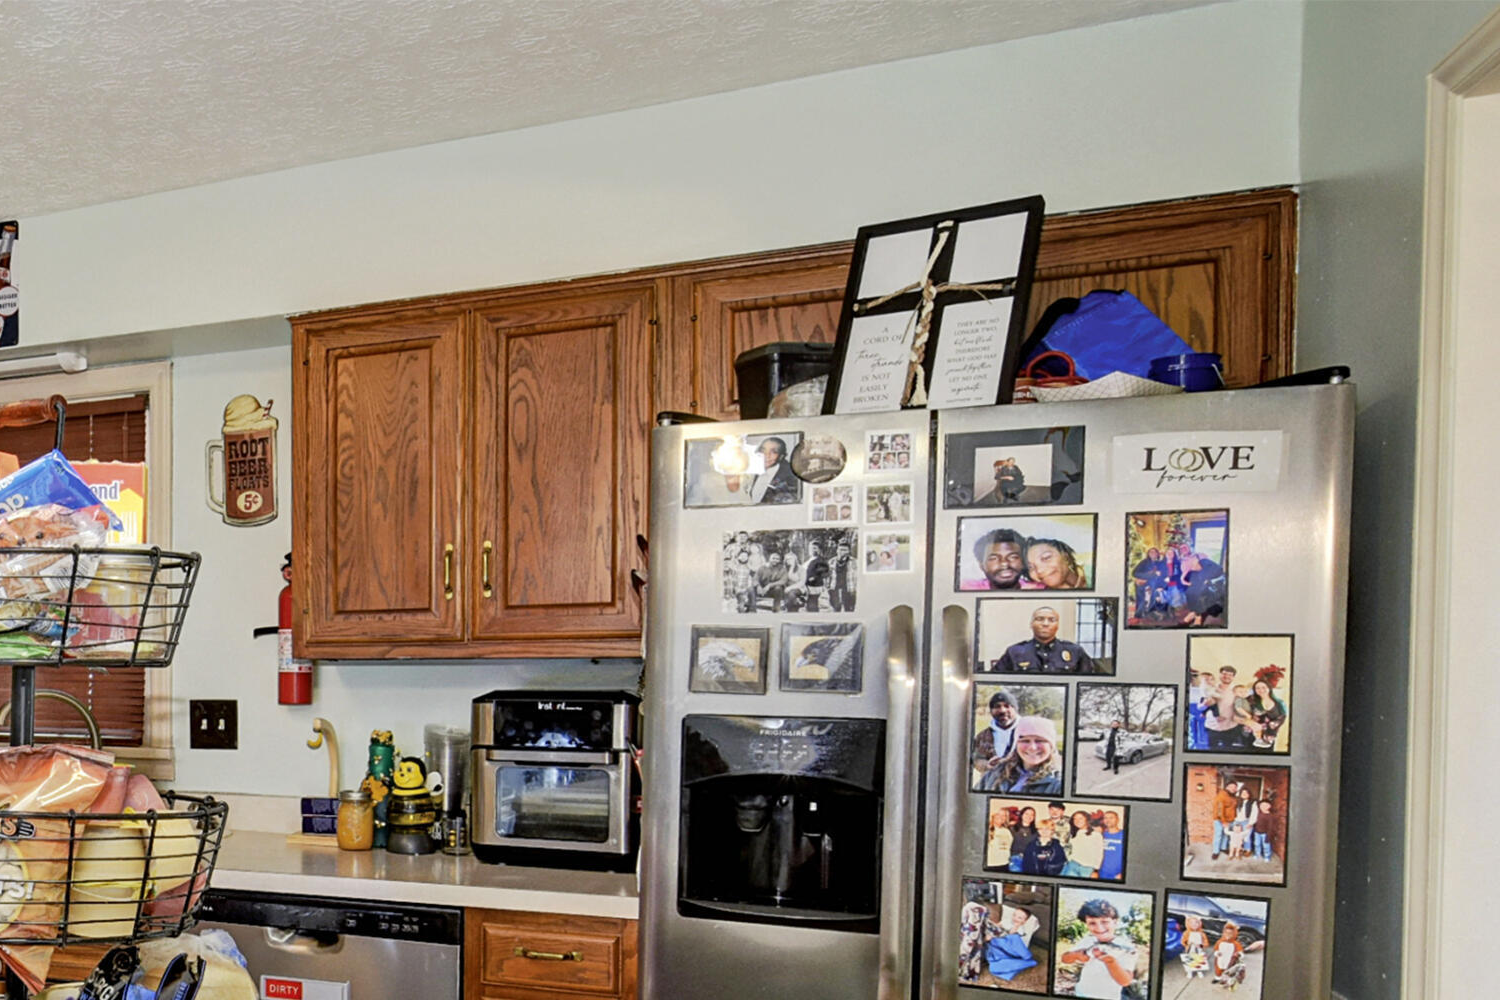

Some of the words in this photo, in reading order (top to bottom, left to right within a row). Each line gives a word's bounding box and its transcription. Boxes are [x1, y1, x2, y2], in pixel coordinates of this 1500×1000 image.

[228, 437, 269, 459] ROOT
[229, 457, 268, 477] BEER
[229, 475, 269, 491] FLOATS
[1156, 470, 1238, 488] forever
[244, 494, 259, 511] 5¢
[759, 729, 807, 738] FRIGIDAIRE
[269, 983, 300, 995] DIRTY
